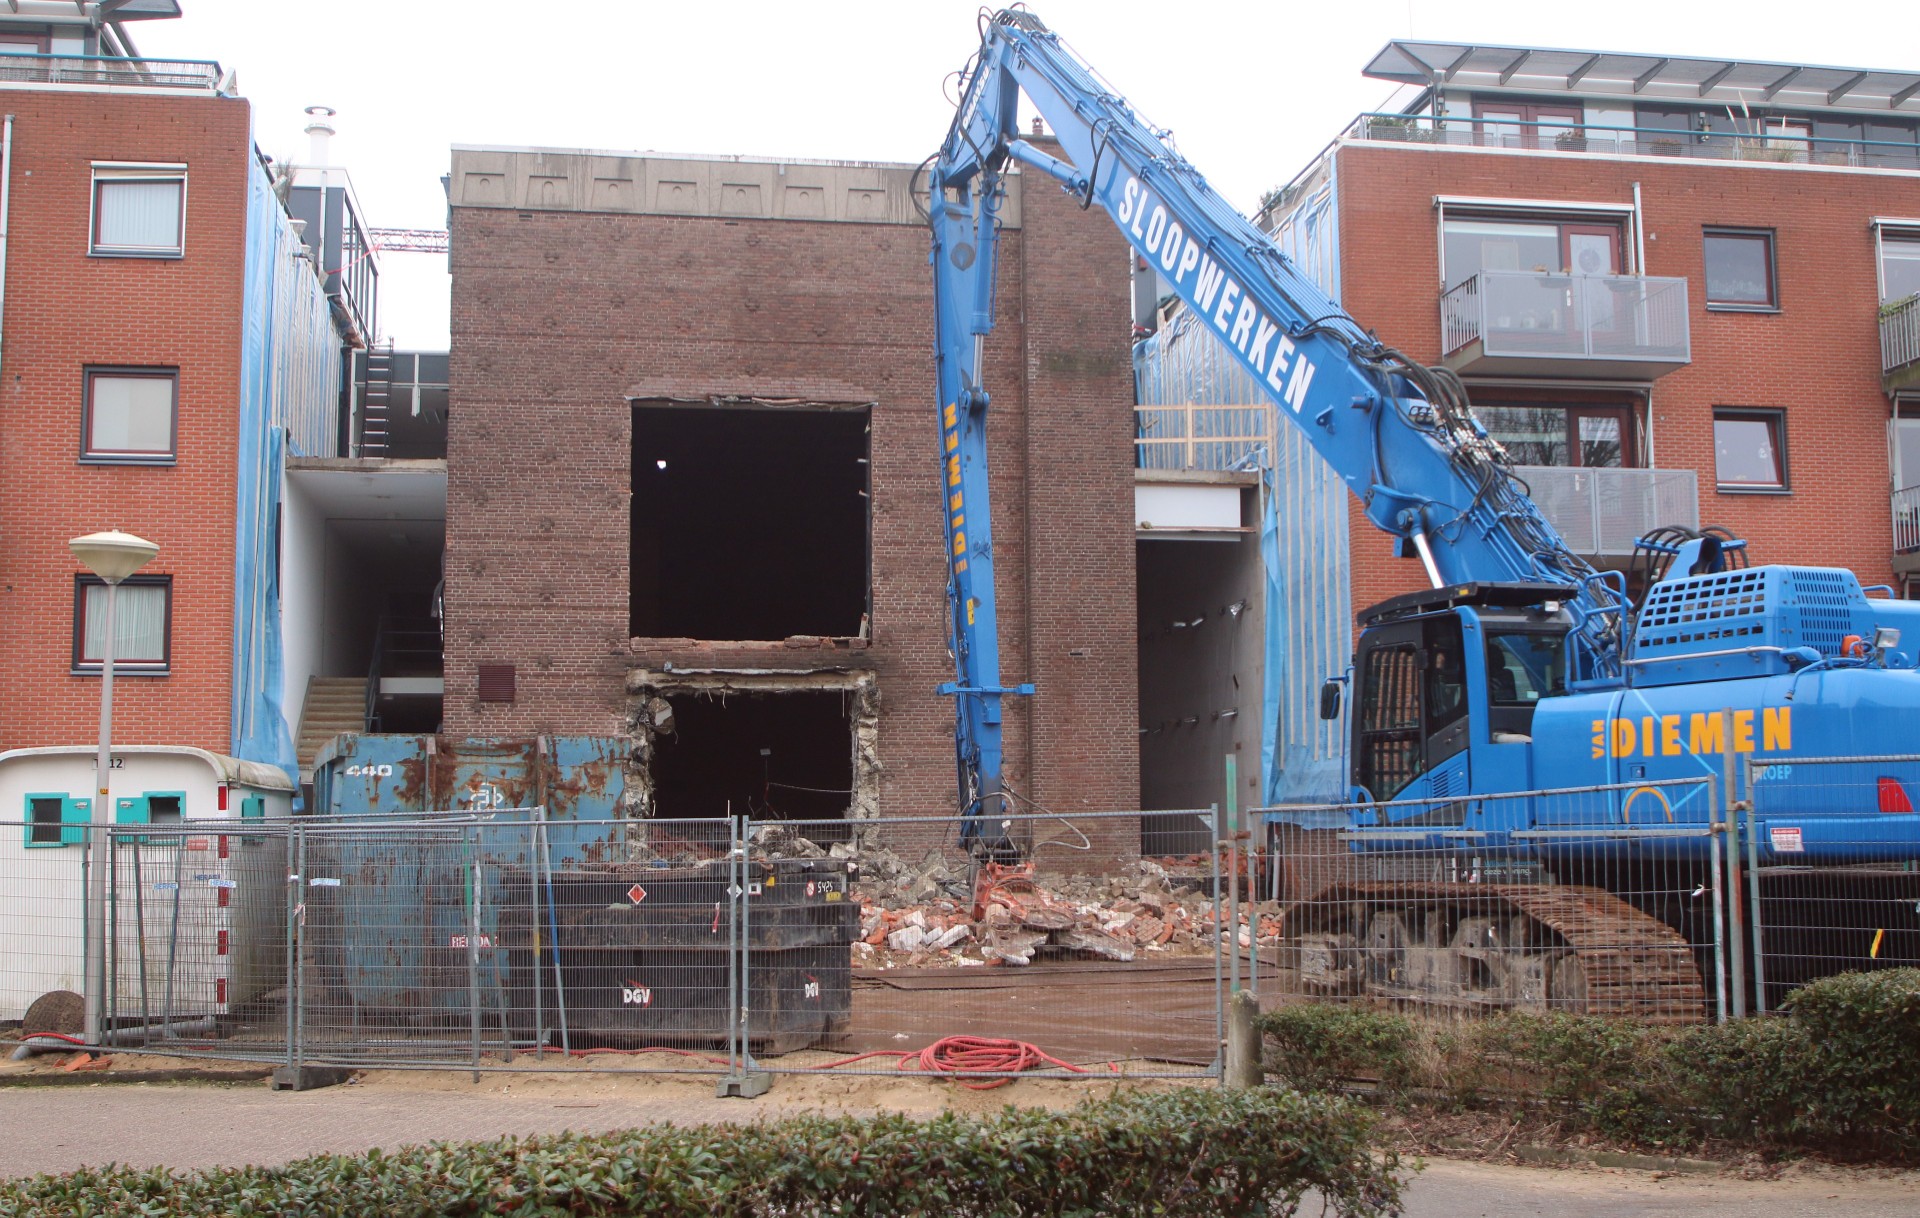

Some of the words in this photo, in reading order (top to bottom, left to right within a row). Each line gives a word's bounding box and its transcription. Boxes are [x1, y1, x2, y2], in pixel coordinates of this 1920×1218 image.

[1118, 177, 1315, 414] SLOOPWERKEN
[944, 402, 967, 556] DIEMEN
[1592, 720, 1605, 759] VAN
[1611, 706, 1792, 758] DIEMEN
[346, 764, 393, 777] 440
[623, 988, 651, 1004] DGV
[805, 982, 819, 999] DGV
